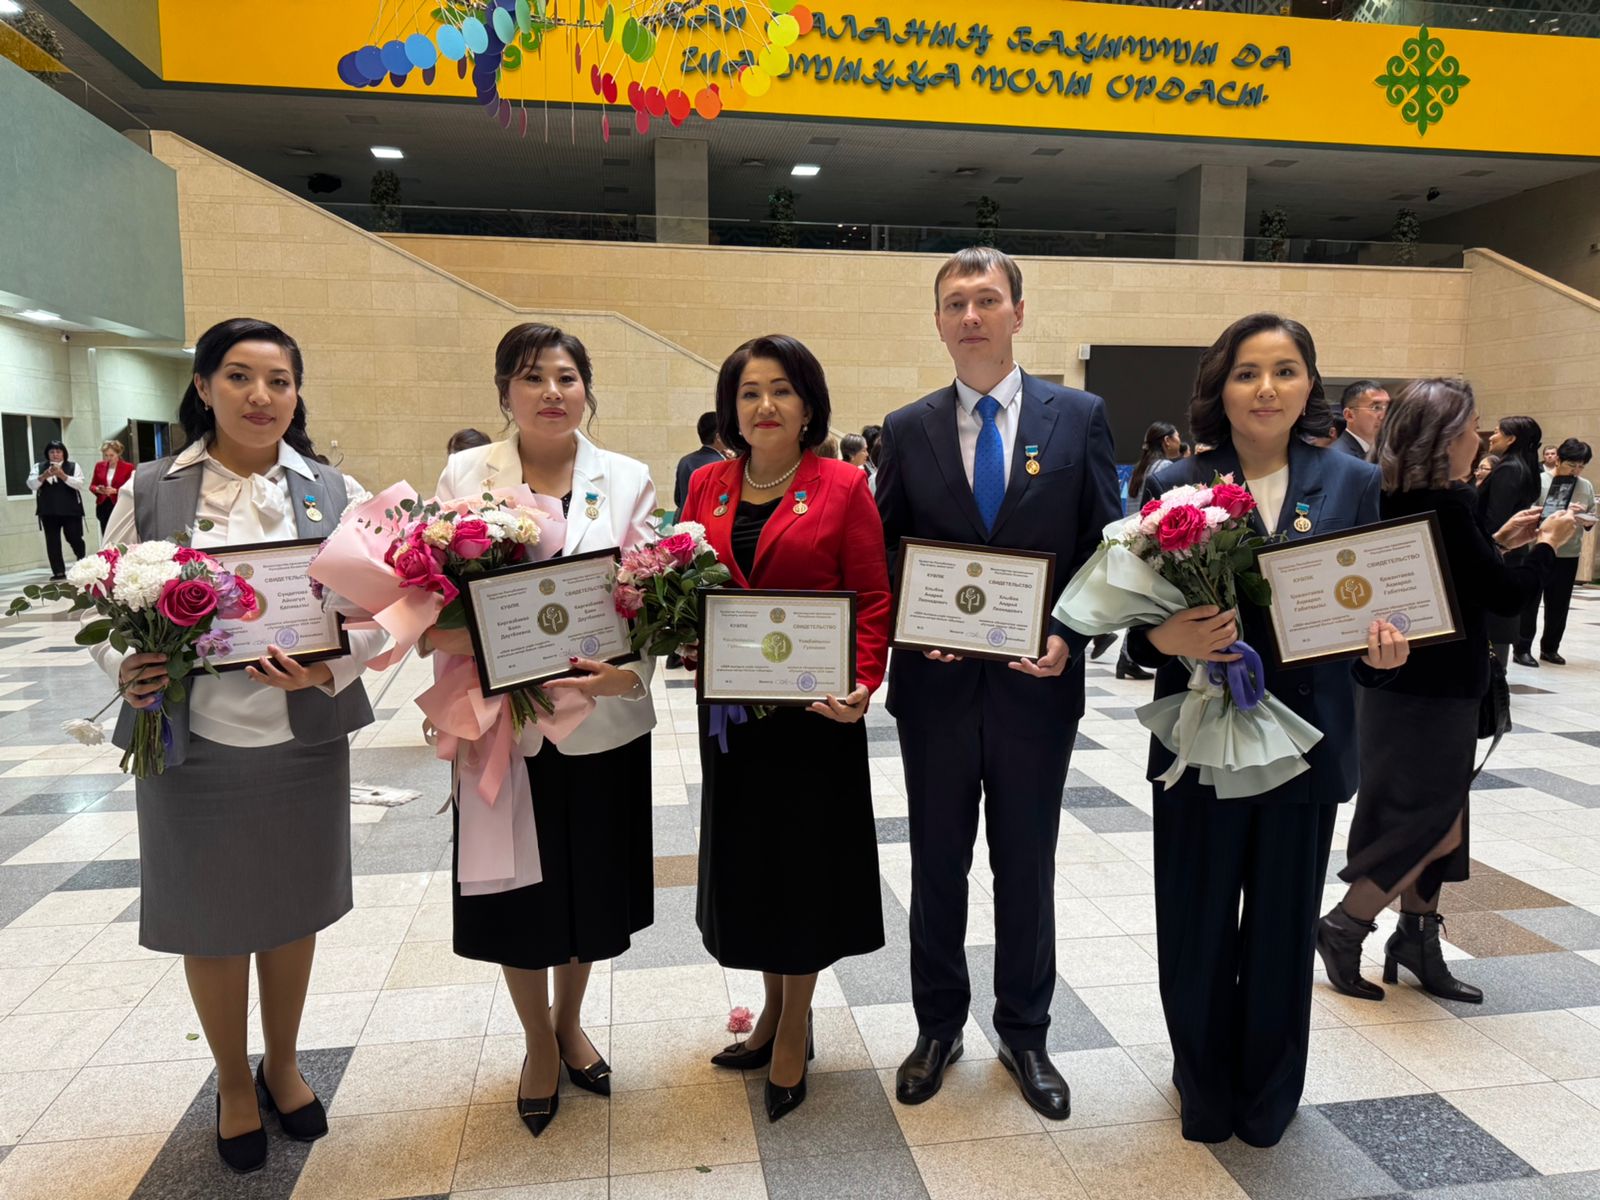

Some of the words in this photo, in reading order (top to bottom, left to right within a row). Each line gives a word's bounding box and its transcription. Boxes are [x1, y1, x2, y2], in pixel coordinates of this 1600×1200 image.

[765, 11, 993, 57] АЛАНЫҢ
[1007, 26, 1220, 65] БАҚЫТТЫ
[1231, 43, 1292, 69] ДА
[972, 64, 1093, 97] ТОЛЫ
[1107, 74, 1270, 107] ОРДАСЫ.
[264, 574, 310, 584] СВИДЕТЕЛЬСТ
[565, 584, 606, 597] СВИДЕТЕЛЬСТВ
